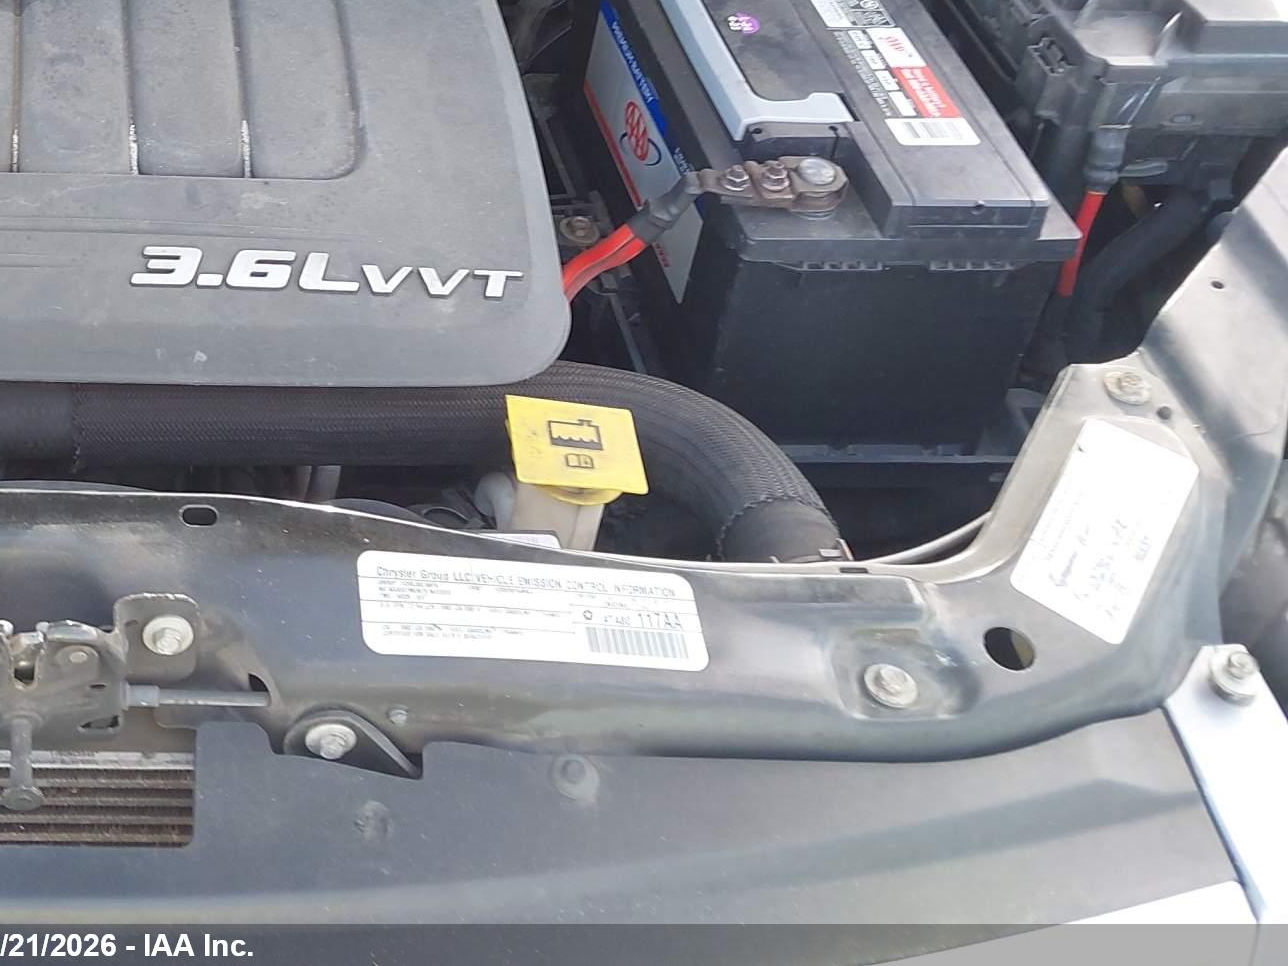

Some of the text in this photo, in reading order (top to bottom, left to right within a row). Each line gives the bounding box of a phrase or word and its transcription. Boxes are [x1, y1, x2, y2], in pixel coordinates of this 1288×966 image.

[452, 571, 472, 582] LLC
[517, 577, 562, 589] EMISSION
[565, 581, 609, 593] CONTROL
[613, 584, 676, 597] INFORMATION
